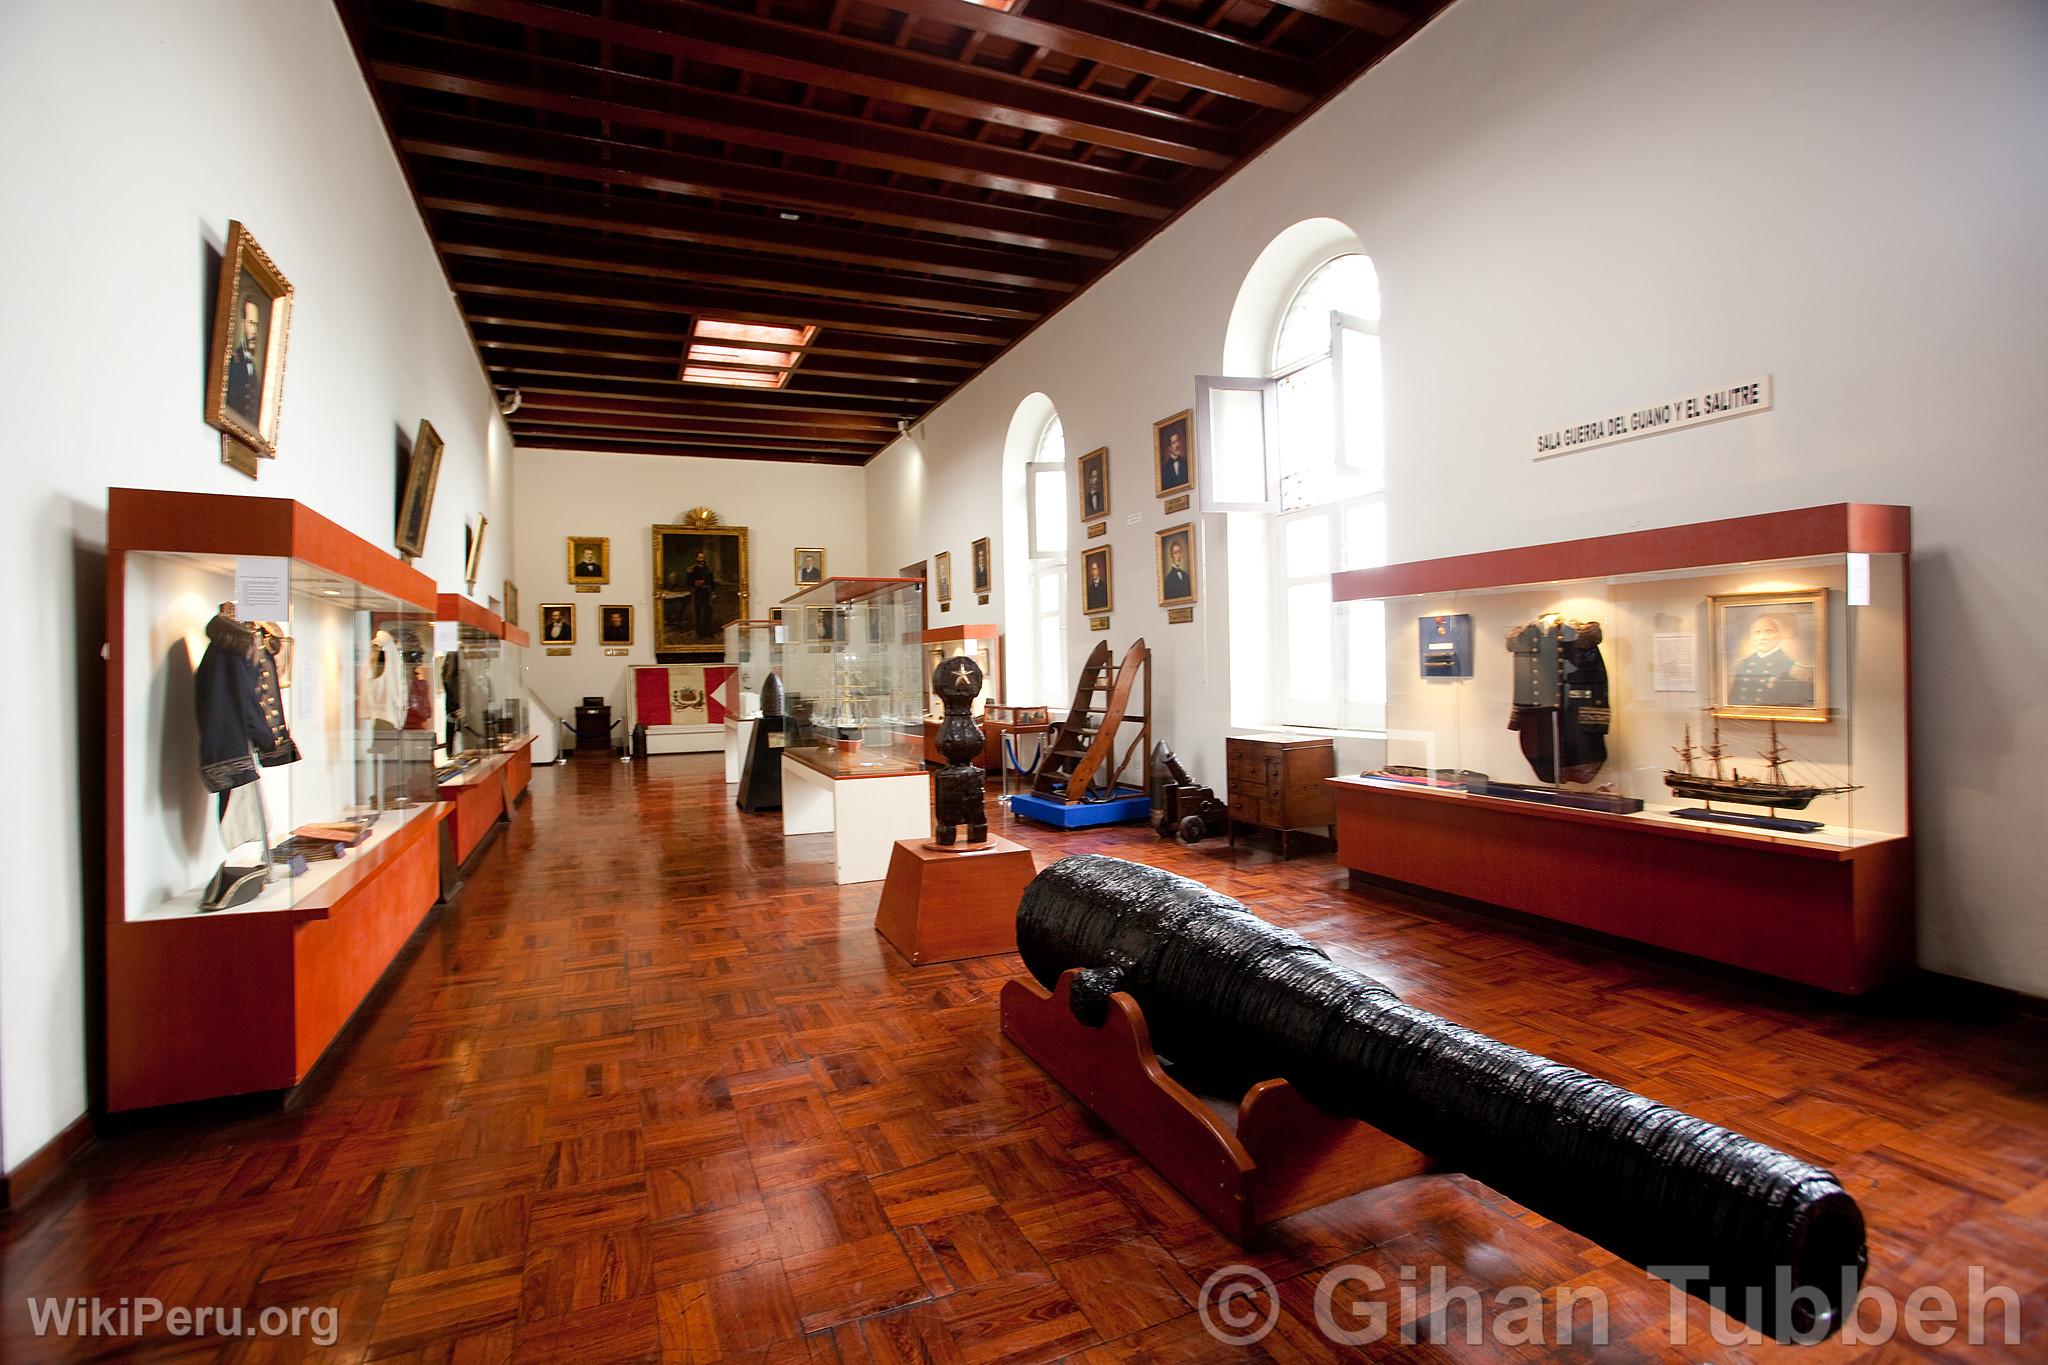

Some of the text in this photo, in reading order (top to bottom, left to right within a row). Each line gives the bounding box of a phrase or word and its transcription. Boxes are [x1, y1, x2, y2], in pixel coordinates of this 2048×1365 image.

[1537, 383, 1759, 452] SALA GUERRA DEL GUANO Y EL SALITRE
